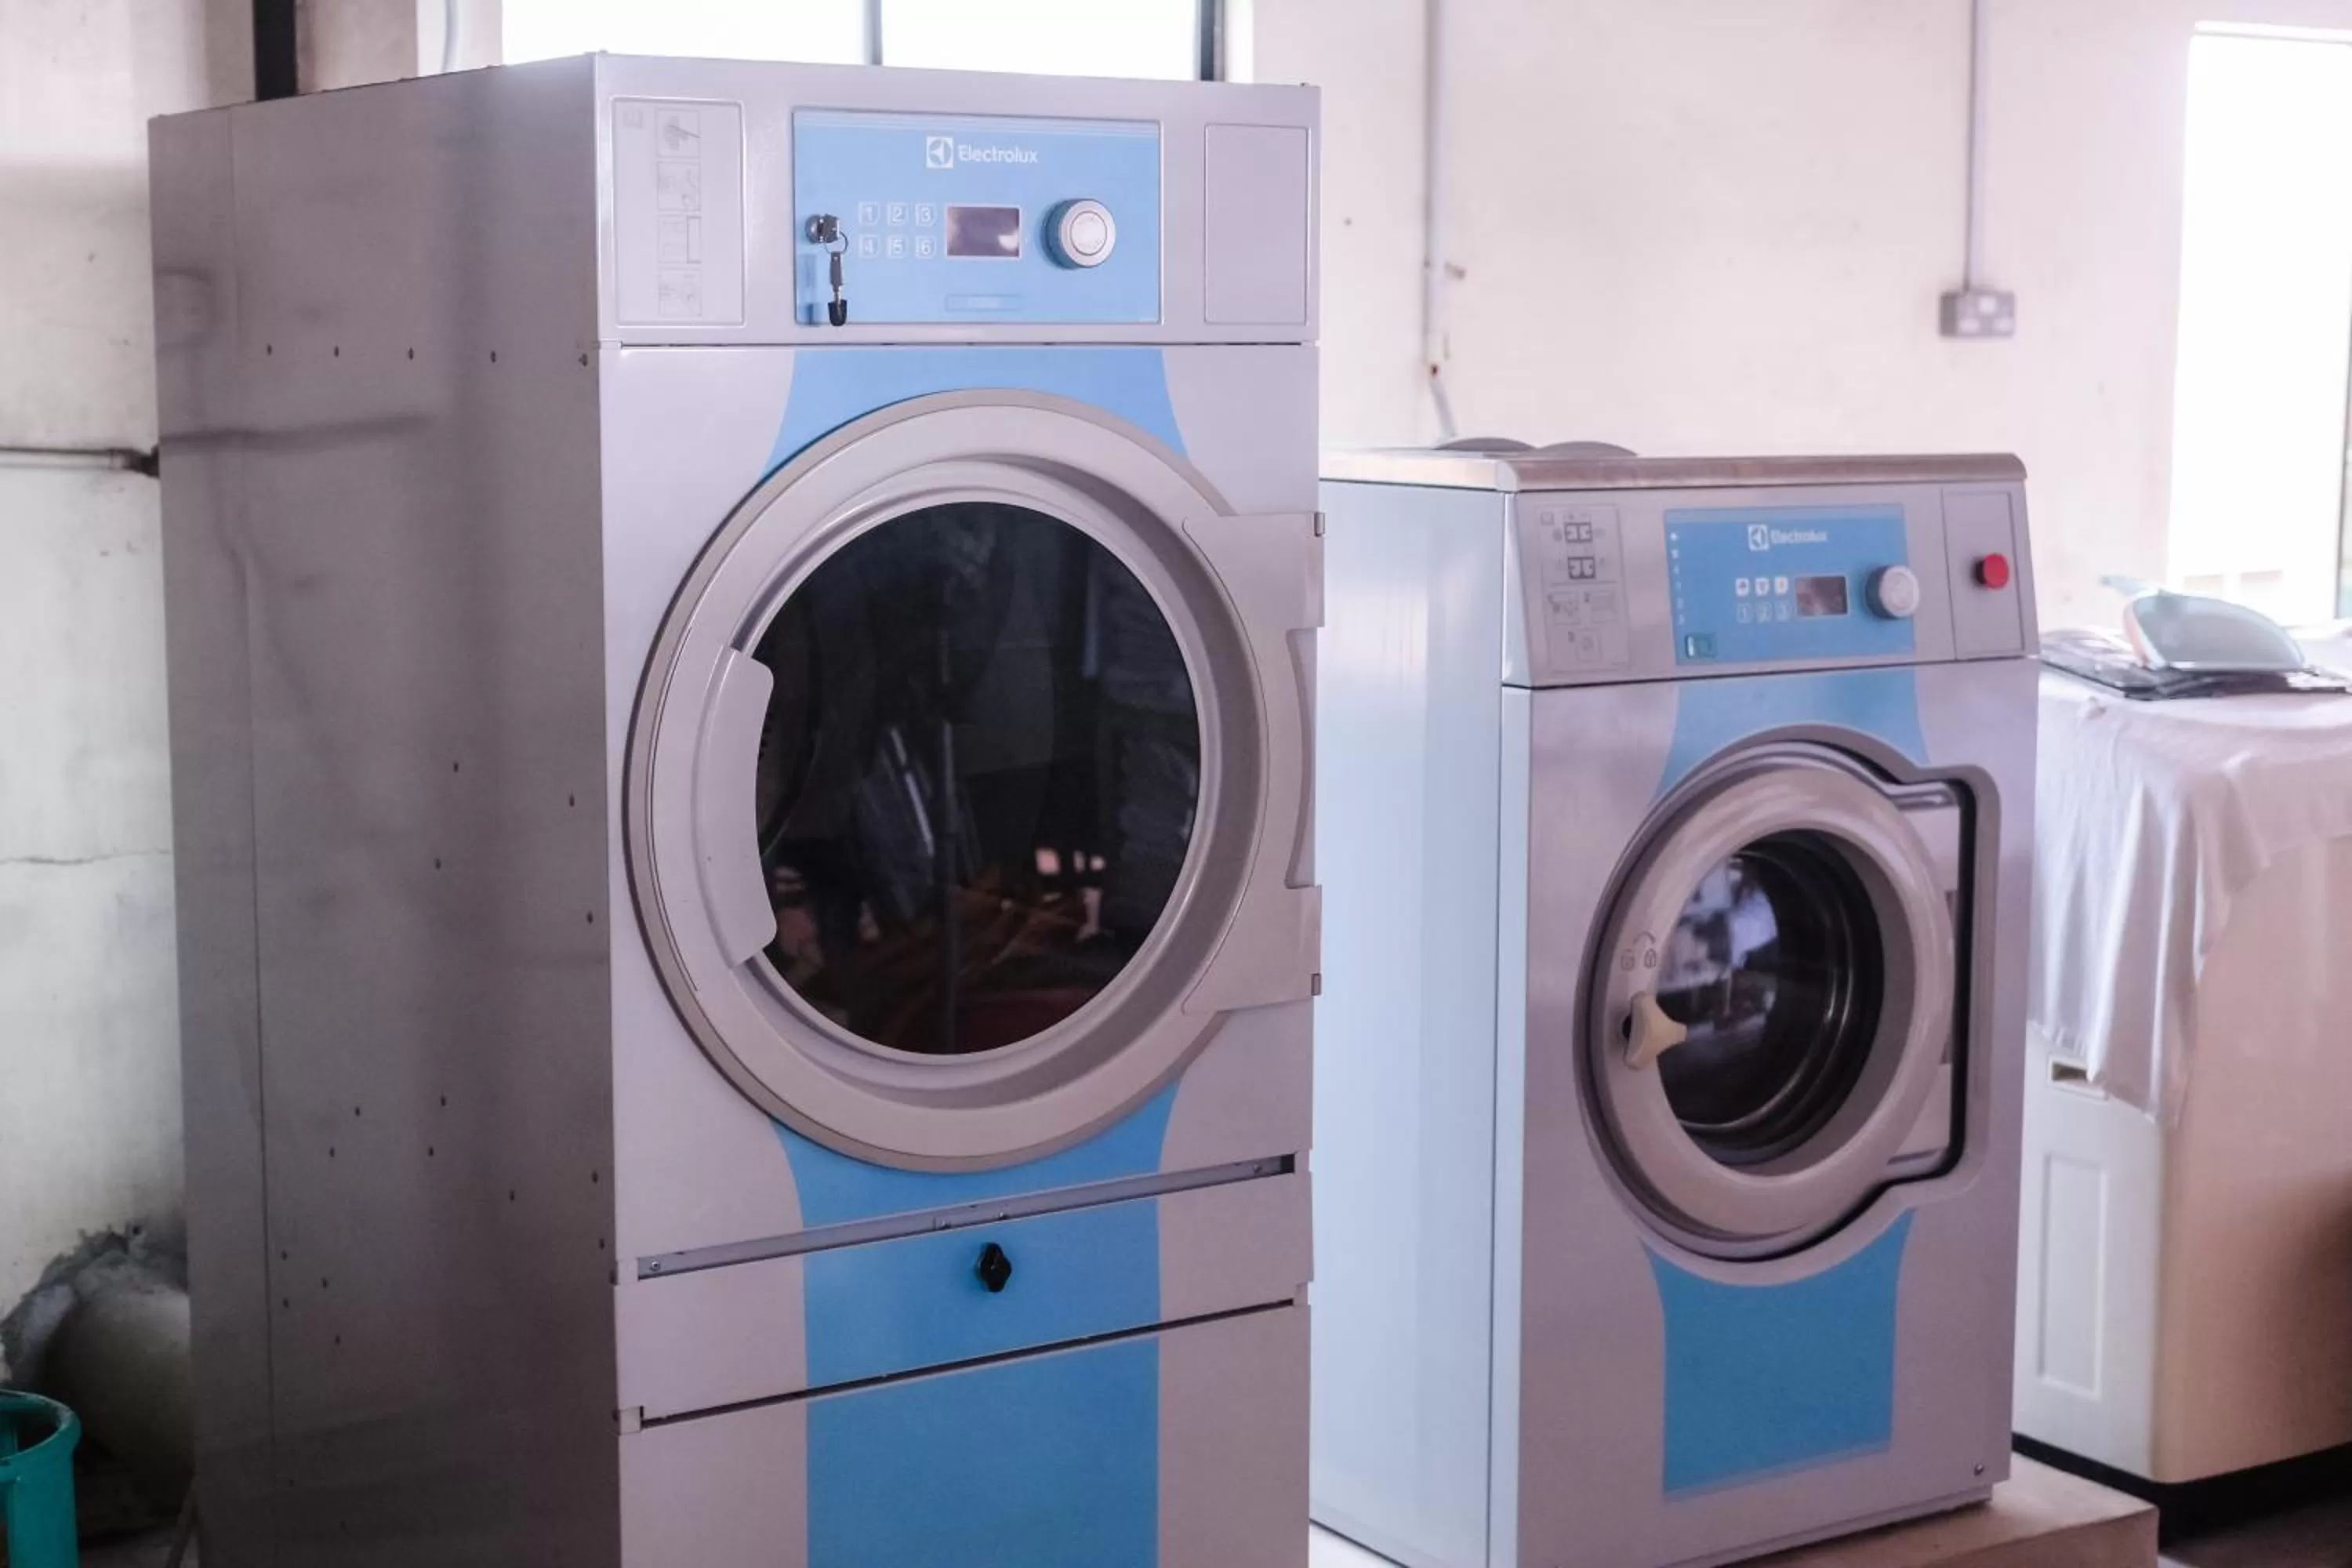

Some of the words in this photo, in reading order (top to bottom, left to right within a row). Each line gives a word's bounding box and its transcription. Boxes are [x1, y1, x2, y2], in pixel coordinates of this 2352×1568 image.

[958, 143, 1038, 164] Electrolux
[863, 205, 873, 221] 1
[892, 206, 904, 222] 2
[920, 207, 931, 222] 3
[865, 238, 873, 252] 4
[893, 238, 902, 254] 5
[920, 239, 931, 255] 6
